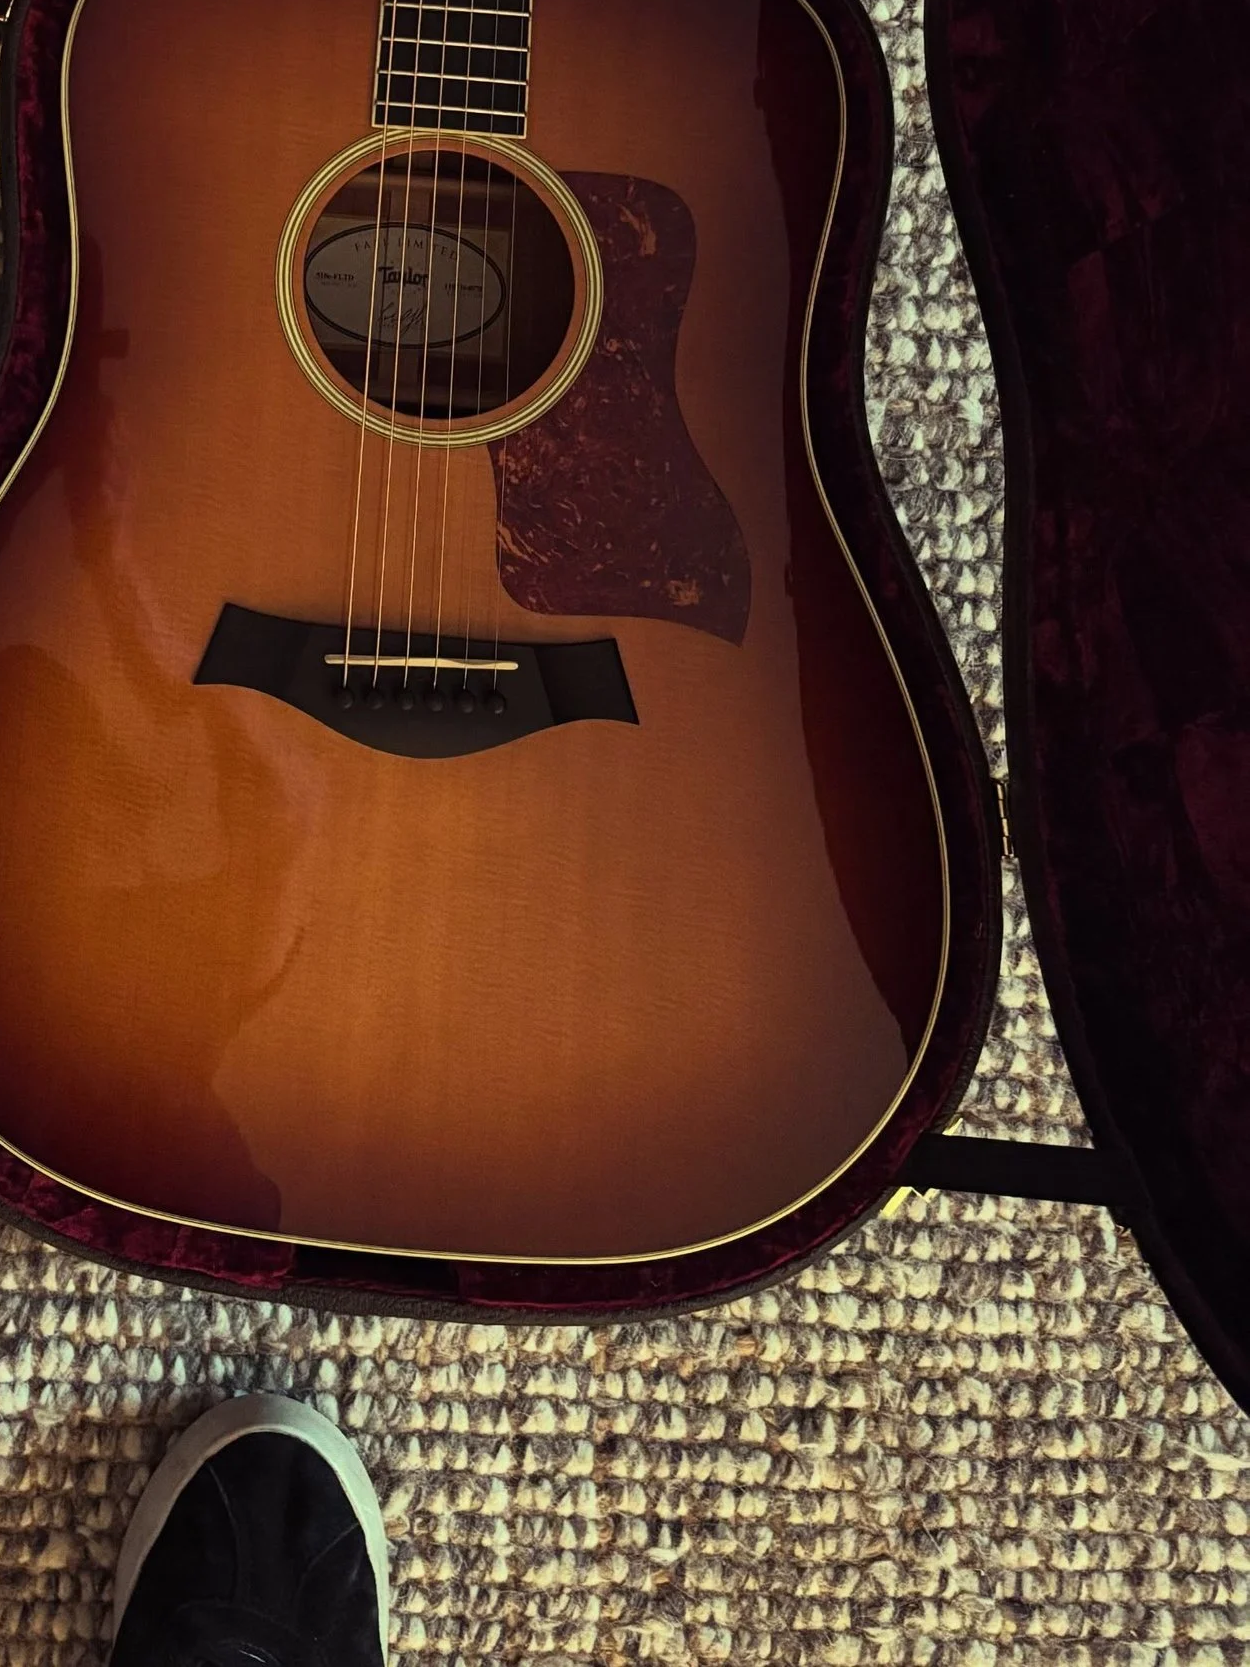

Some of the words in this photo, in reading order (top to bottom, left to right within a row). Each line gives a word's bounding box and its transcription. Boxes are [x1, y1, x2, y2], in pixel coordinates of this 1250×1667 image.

[355, 238, 389, 252] FAL
[398, 237, 458, 260] LIMTED
[377, 266, 429, 288] Taylor
